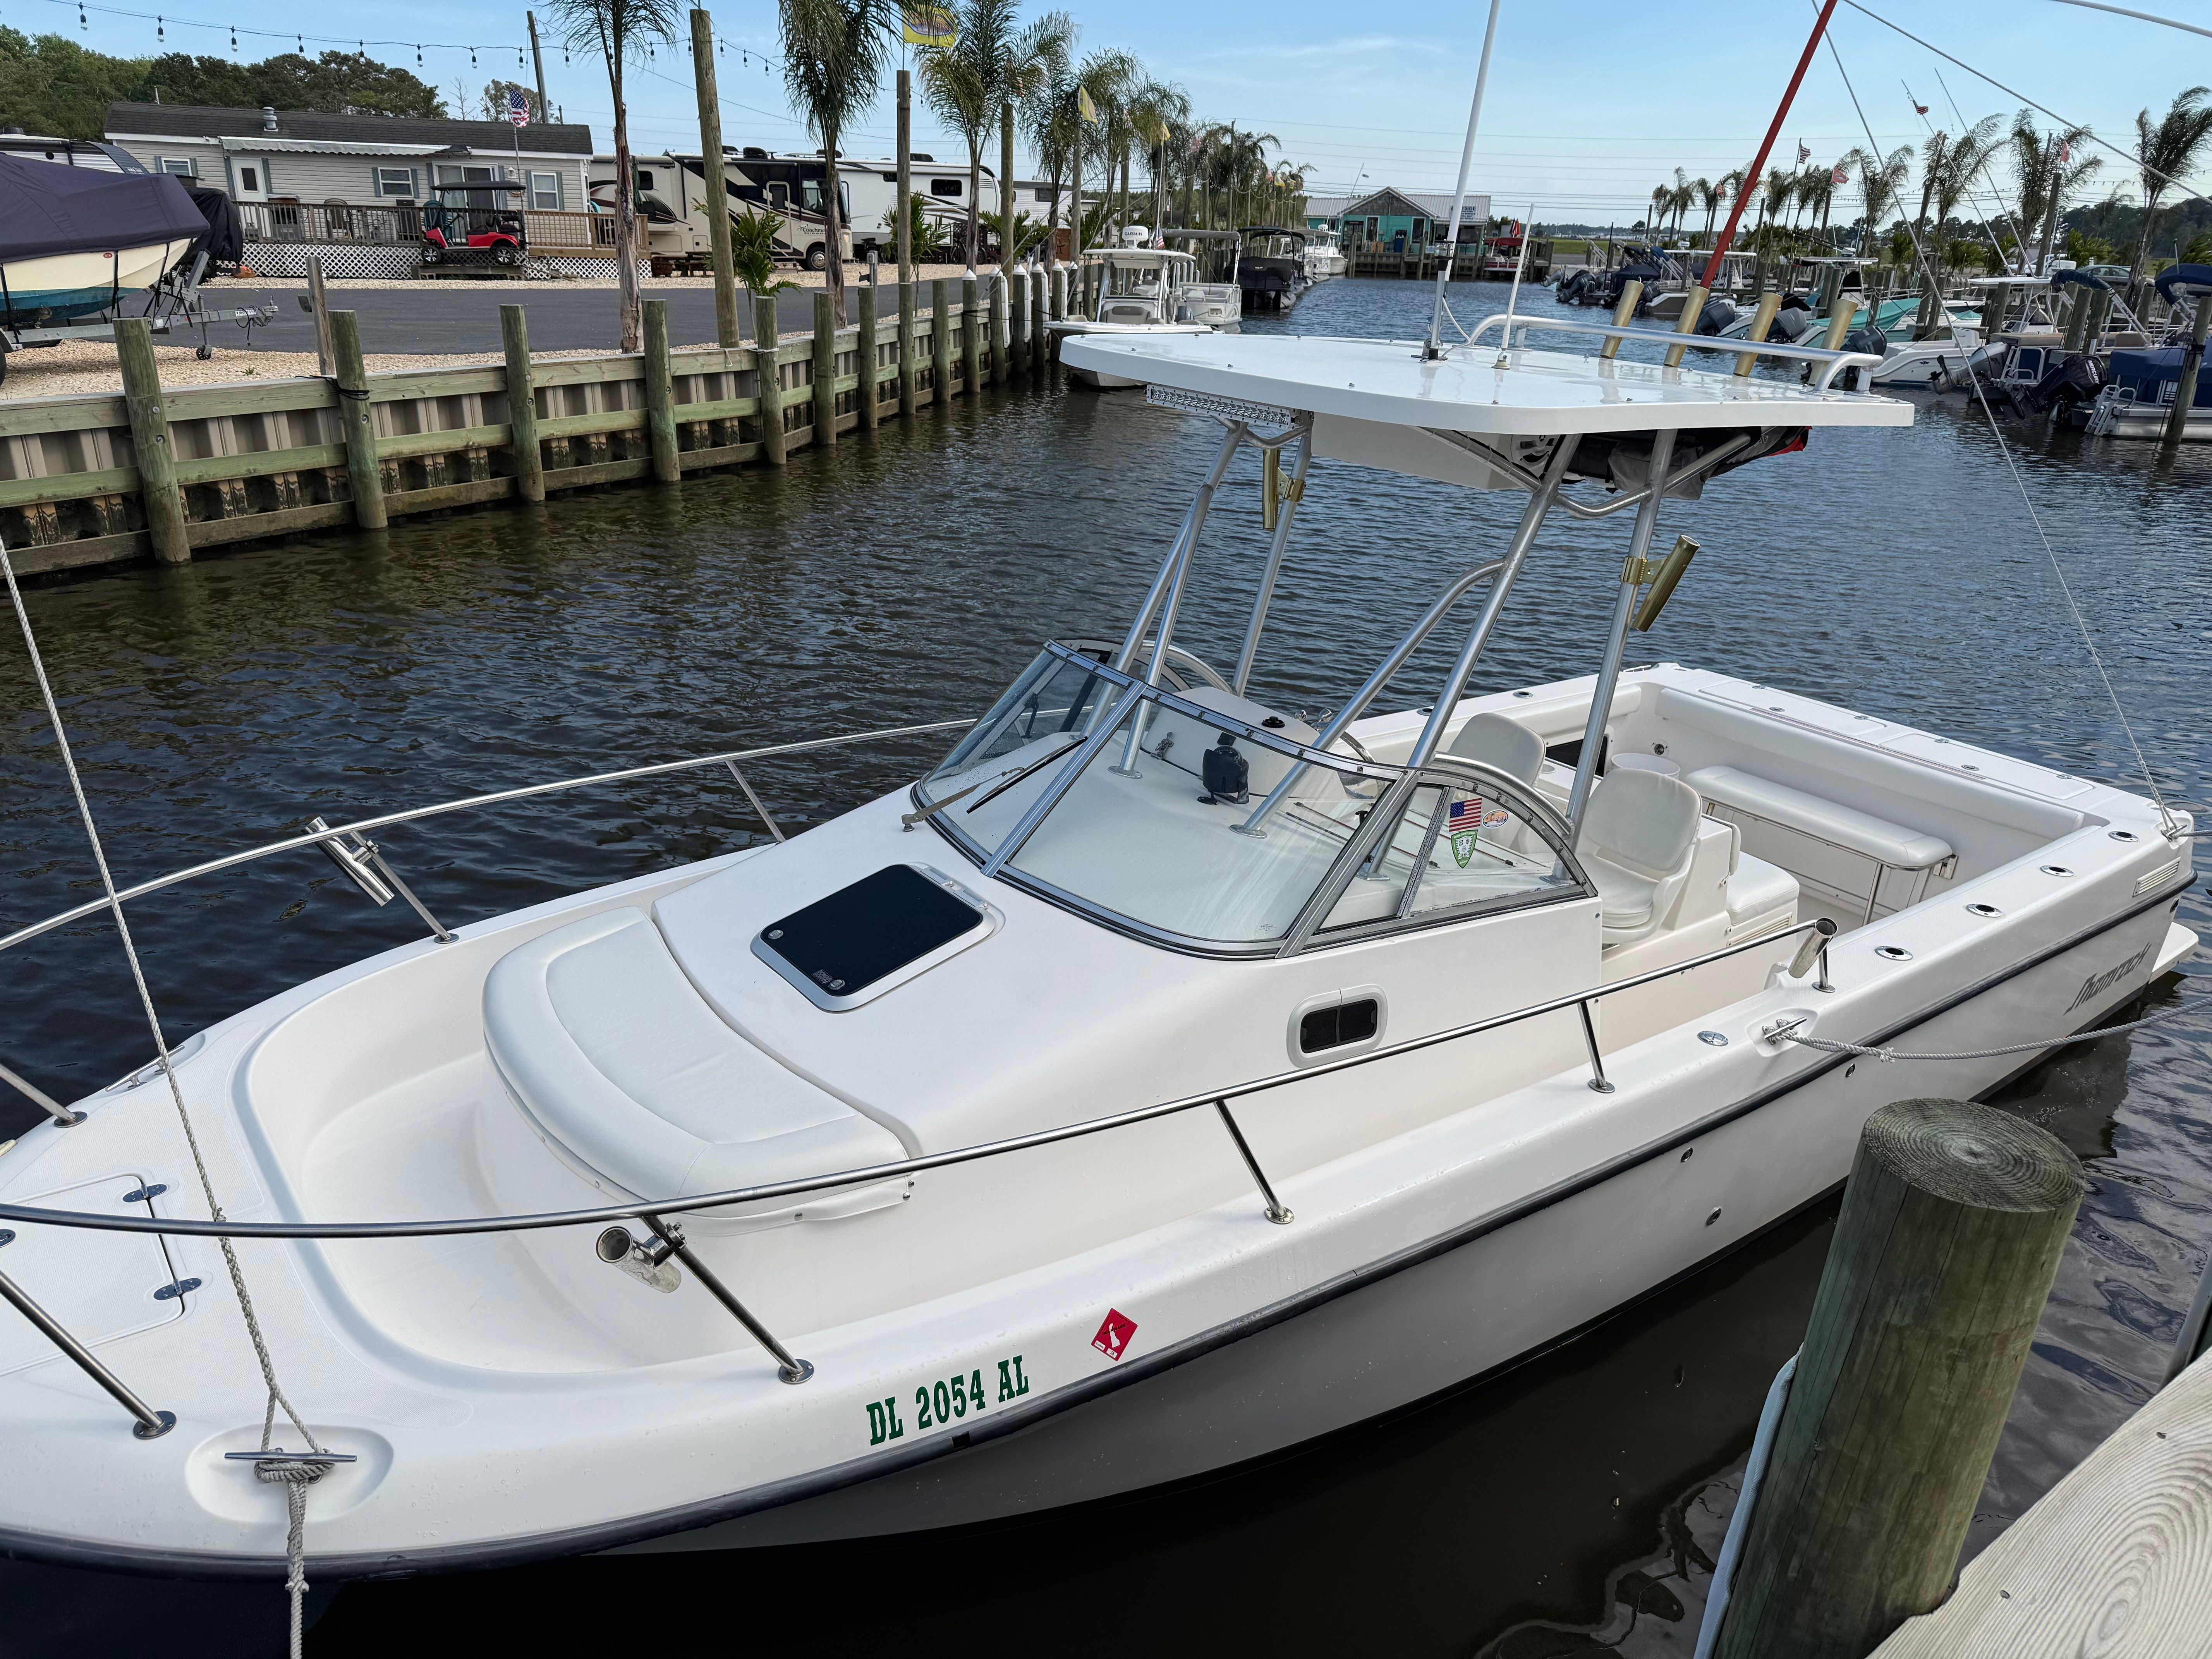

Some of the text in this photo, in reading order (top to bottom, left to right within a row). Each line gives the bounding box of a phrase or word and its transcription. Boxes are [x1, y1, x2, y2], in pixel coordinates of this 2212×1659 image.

[2088, 360, 2100, 384] MERCURY
[1102, 1324, 1127, 1335] DELAWARE
[866, 1355, 1029, 1446] DL 2054 AL
